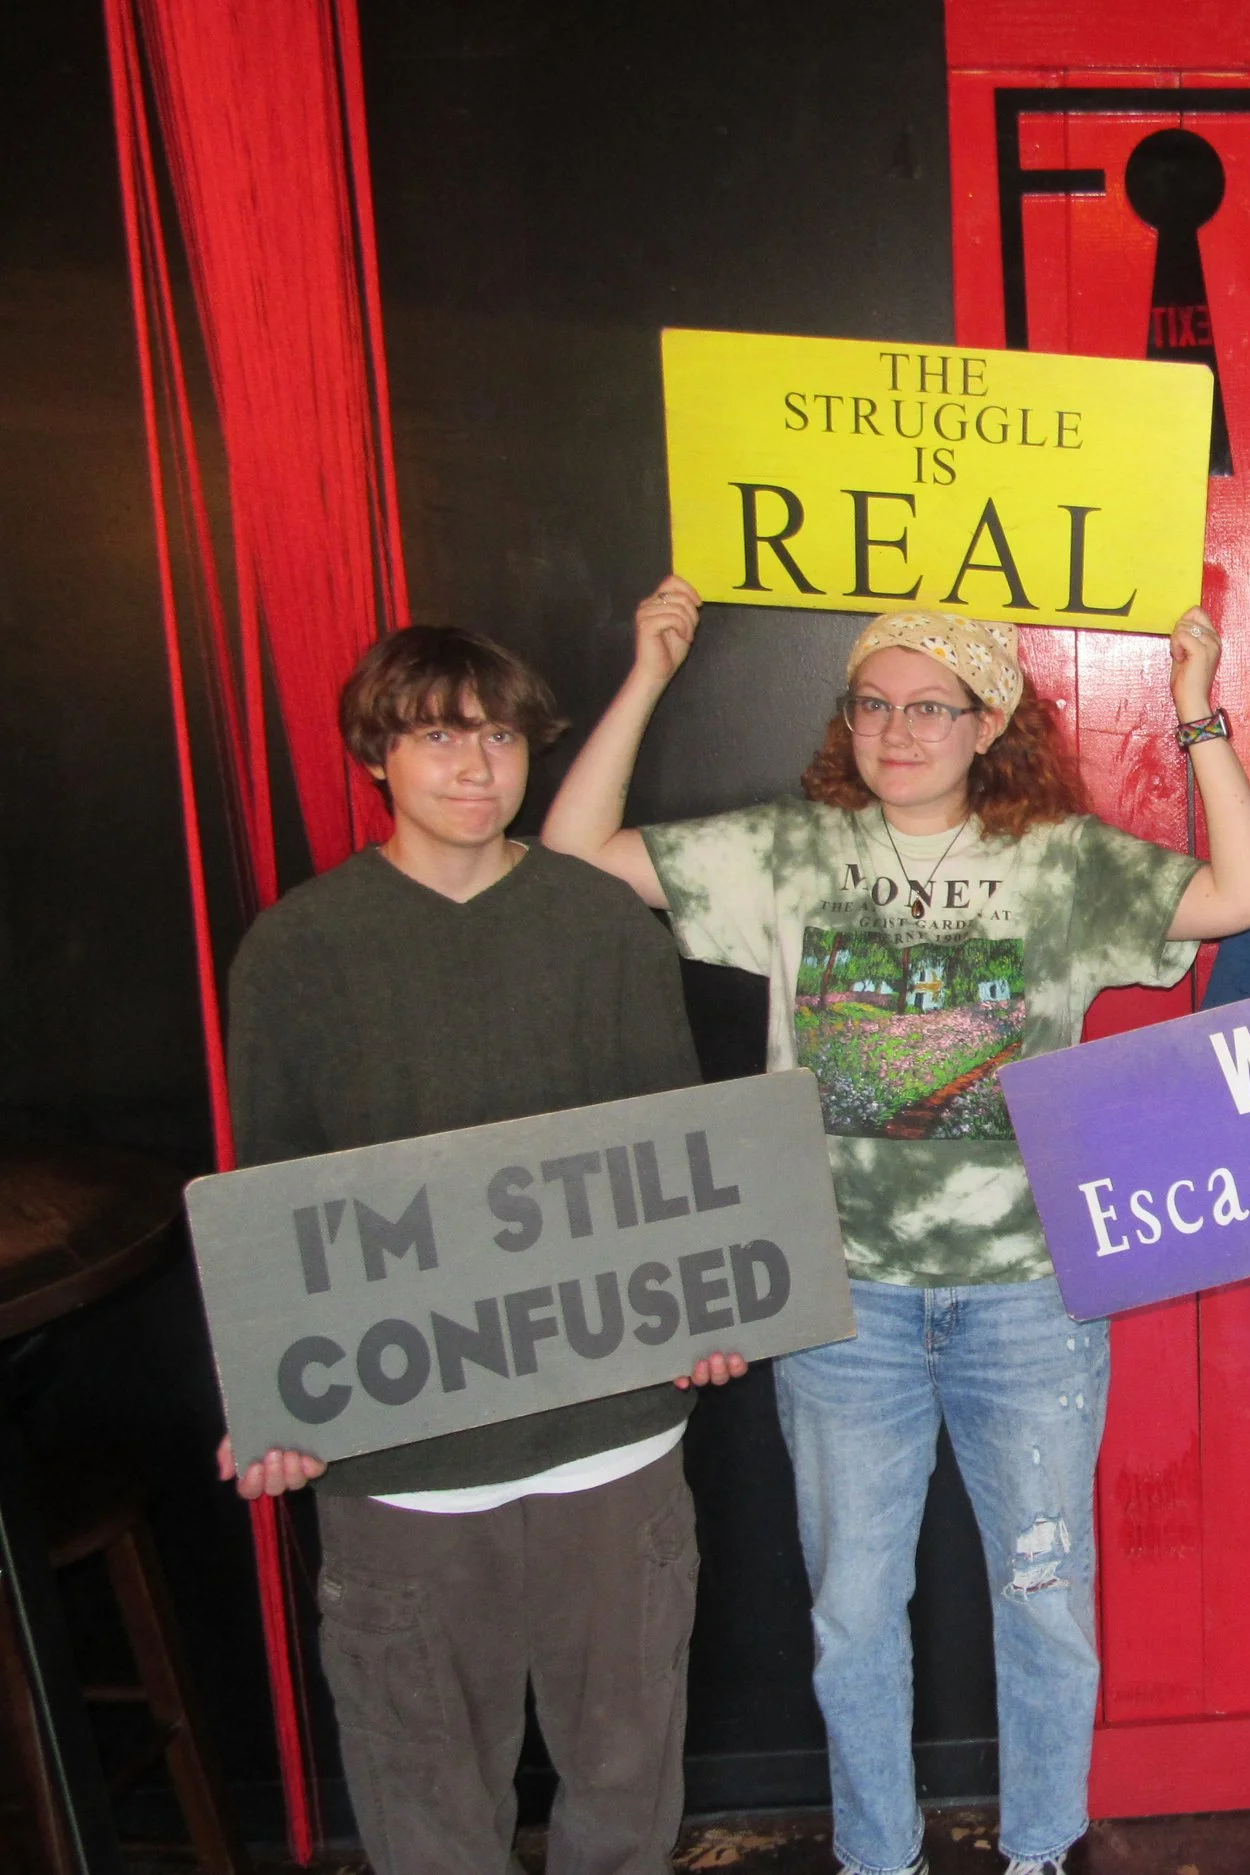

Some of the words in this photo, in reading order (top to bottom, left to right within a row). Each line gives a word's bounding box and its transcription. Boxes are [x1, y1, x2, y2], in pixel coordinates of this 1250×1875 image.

[879, 352, 989, 397] THE
[783, 392, 1084, 450] STRUGGLE
[912, 446, 958, 486] IS
[728, 481, 1139, 618] REAL
[990, 909, 1012, 921] AT
[292, 1182, 440, 1296] I'M
[486, 1129, 741, 1253] STILL
[277, 1238, 792, 1426] CONFUSED
